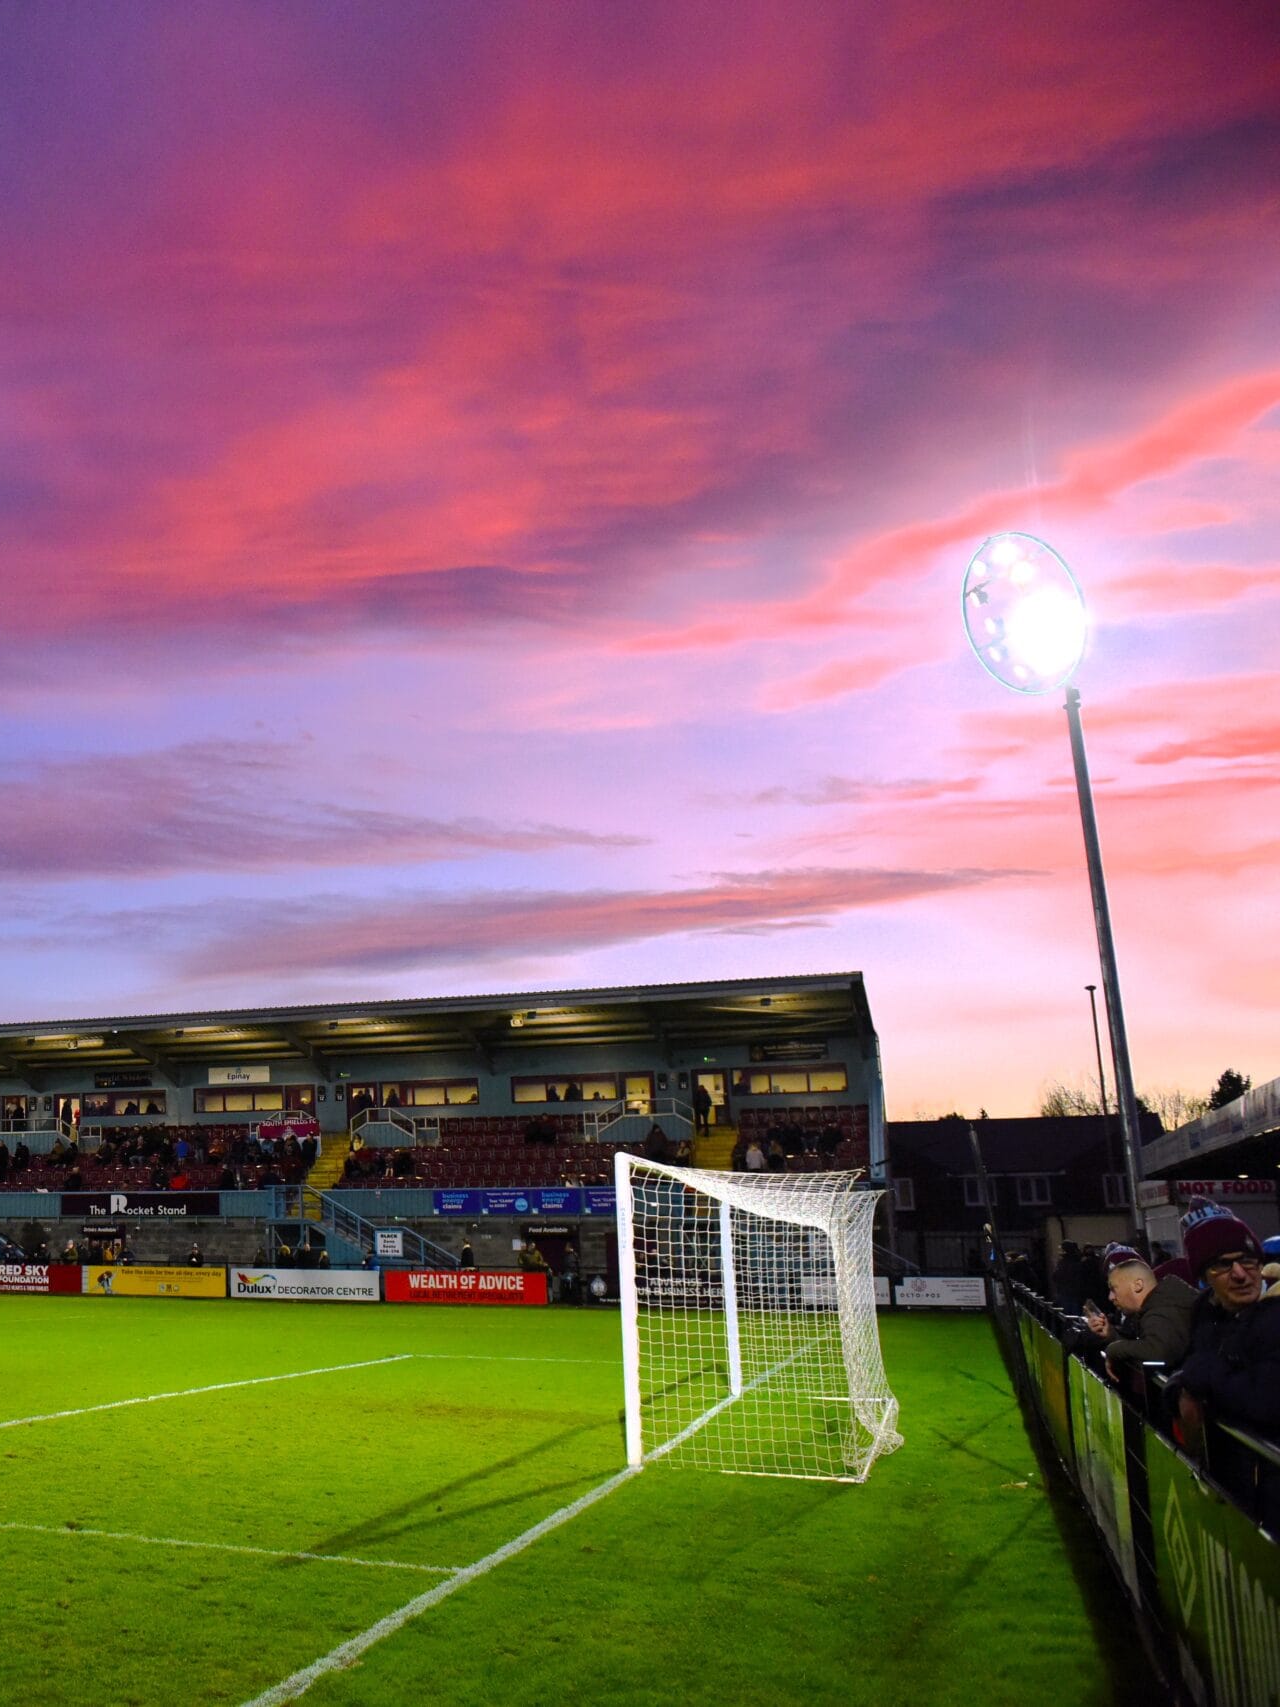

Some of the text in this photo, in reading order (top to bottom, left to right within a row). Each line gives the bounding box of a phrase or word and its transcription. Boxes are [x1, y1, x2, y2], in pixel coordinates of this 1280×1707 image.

[227, 1072, 250, 1081] Epinay
[1179, 1182, 1216, 1195] HOT
[1222, 1181, 1272, 1194] FOOD
[89, 1194, 187, 1216] The Rocket Stand
[25, 1265, 49, 1276] SKY
[237, 1282, 374, 1296] Dulux DECORATOR CENTRE
[409, 1274, 524, 1291] WEALTH OF ADVICE
